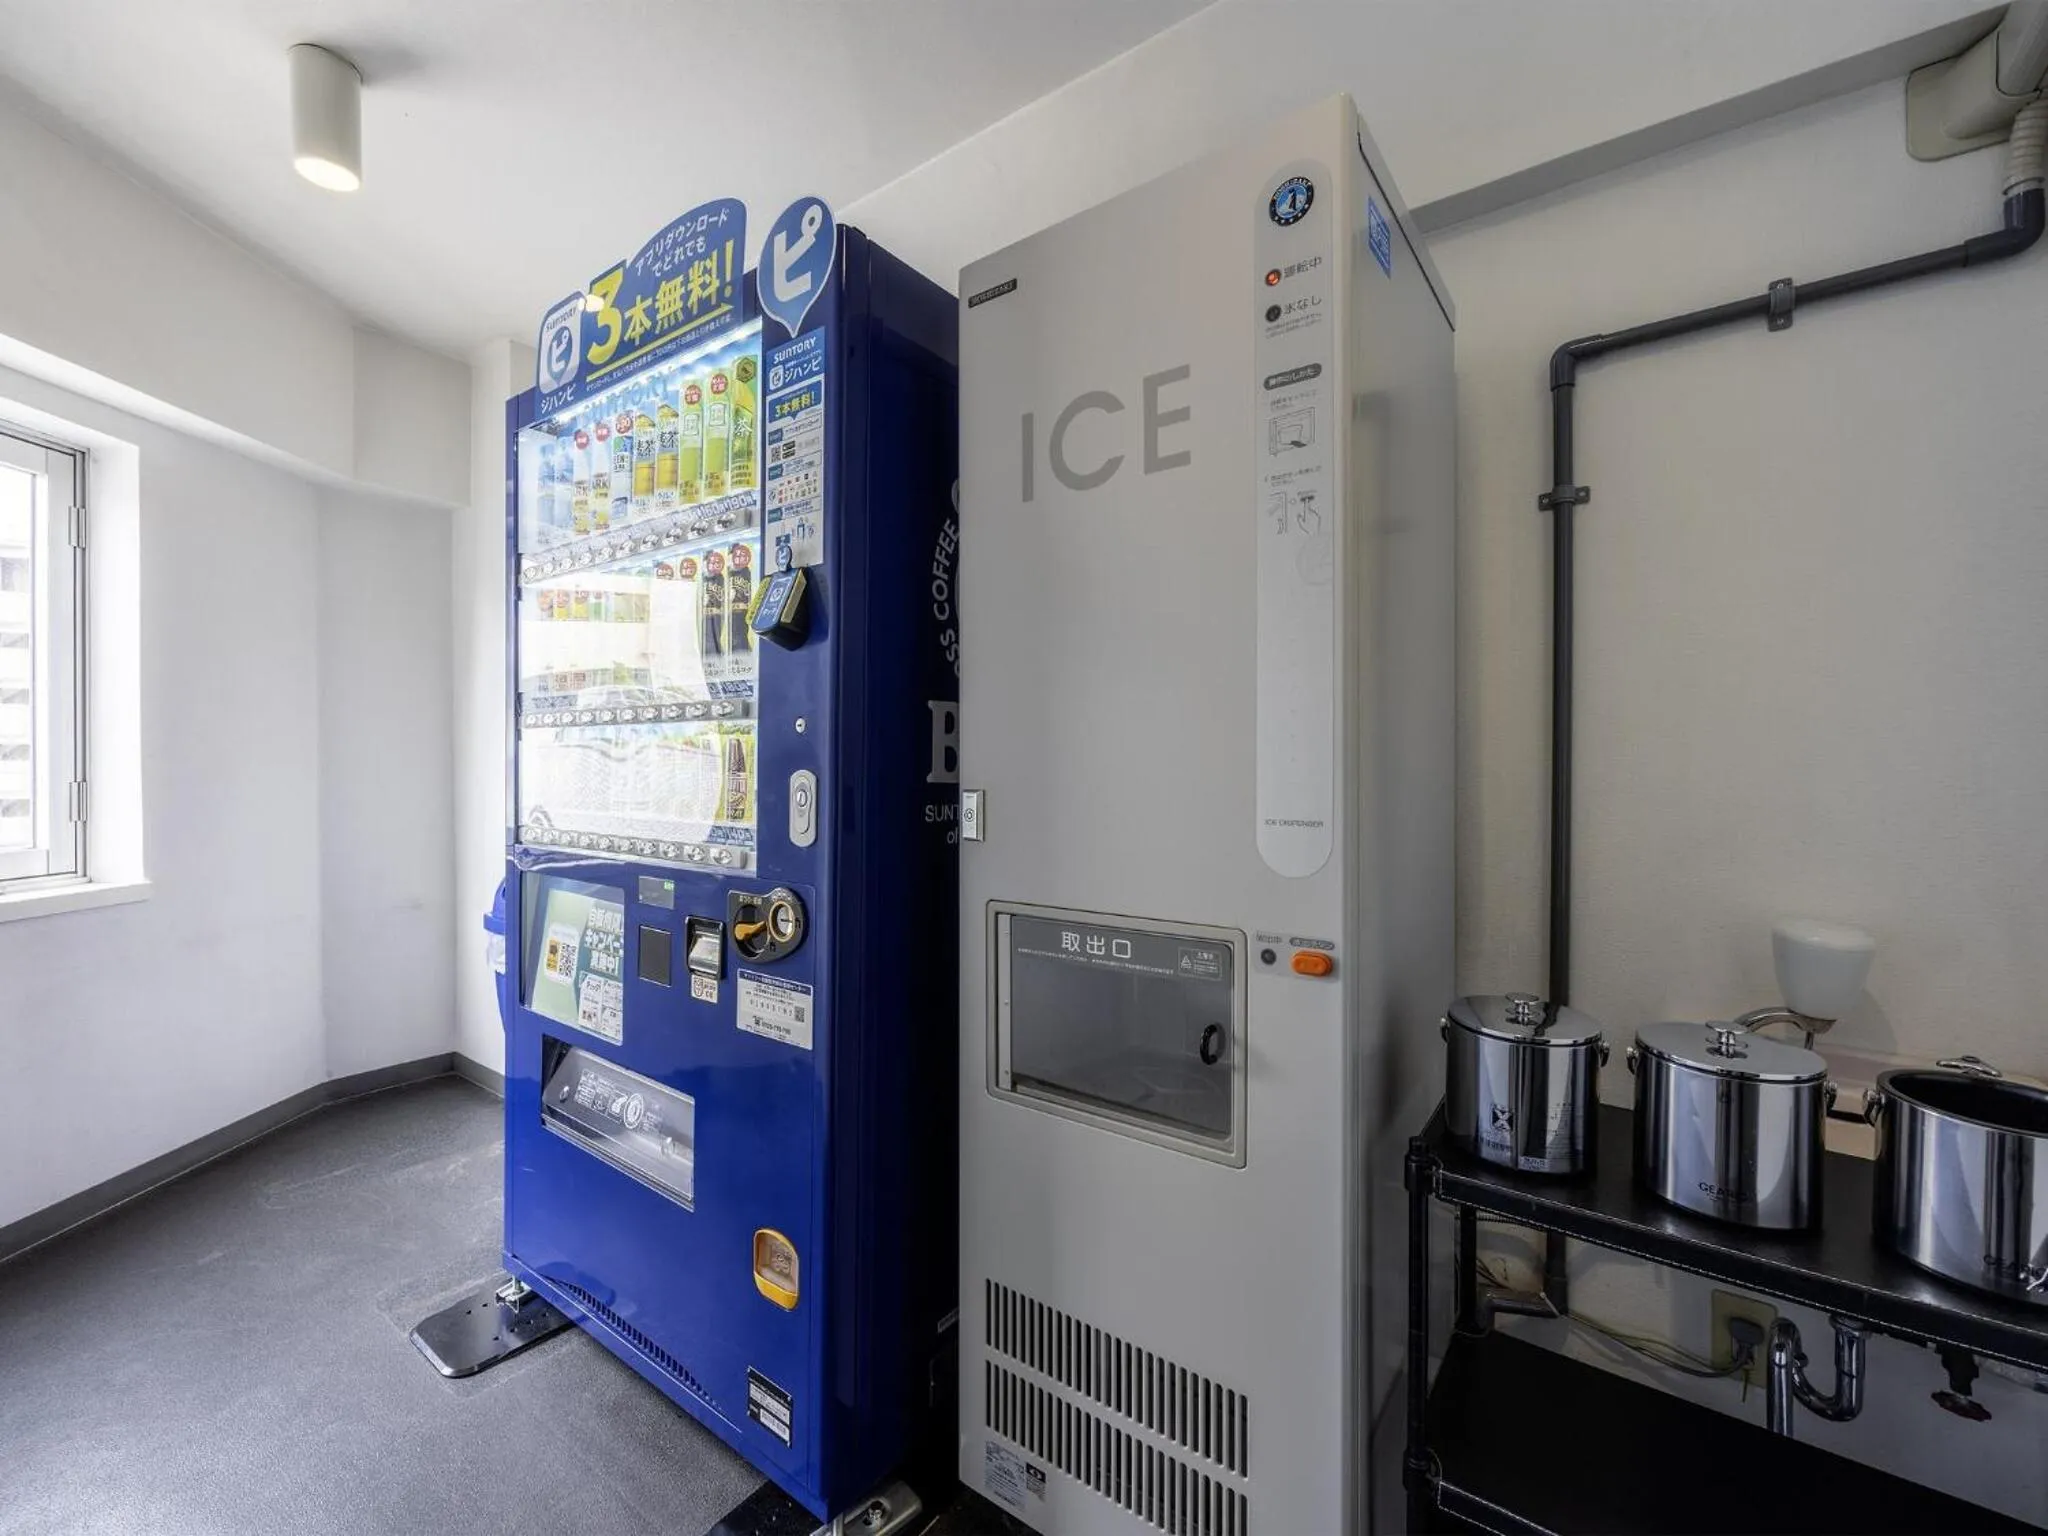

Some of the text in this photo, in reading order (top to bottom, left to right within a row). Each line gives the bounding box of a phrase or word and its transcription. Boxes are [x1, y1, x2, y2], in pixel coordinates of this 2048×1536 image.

[635, 207, 730, 277] アプリダウンロード
[653, 236, 706, 277] でどれでも
[586, 238, 735, 365] 3本無料!
[773, 336, 817, 365] SUNTORY
[1022, 364, 1191, 502] ICE
[1061, 931, 1131, 959] 取出口
